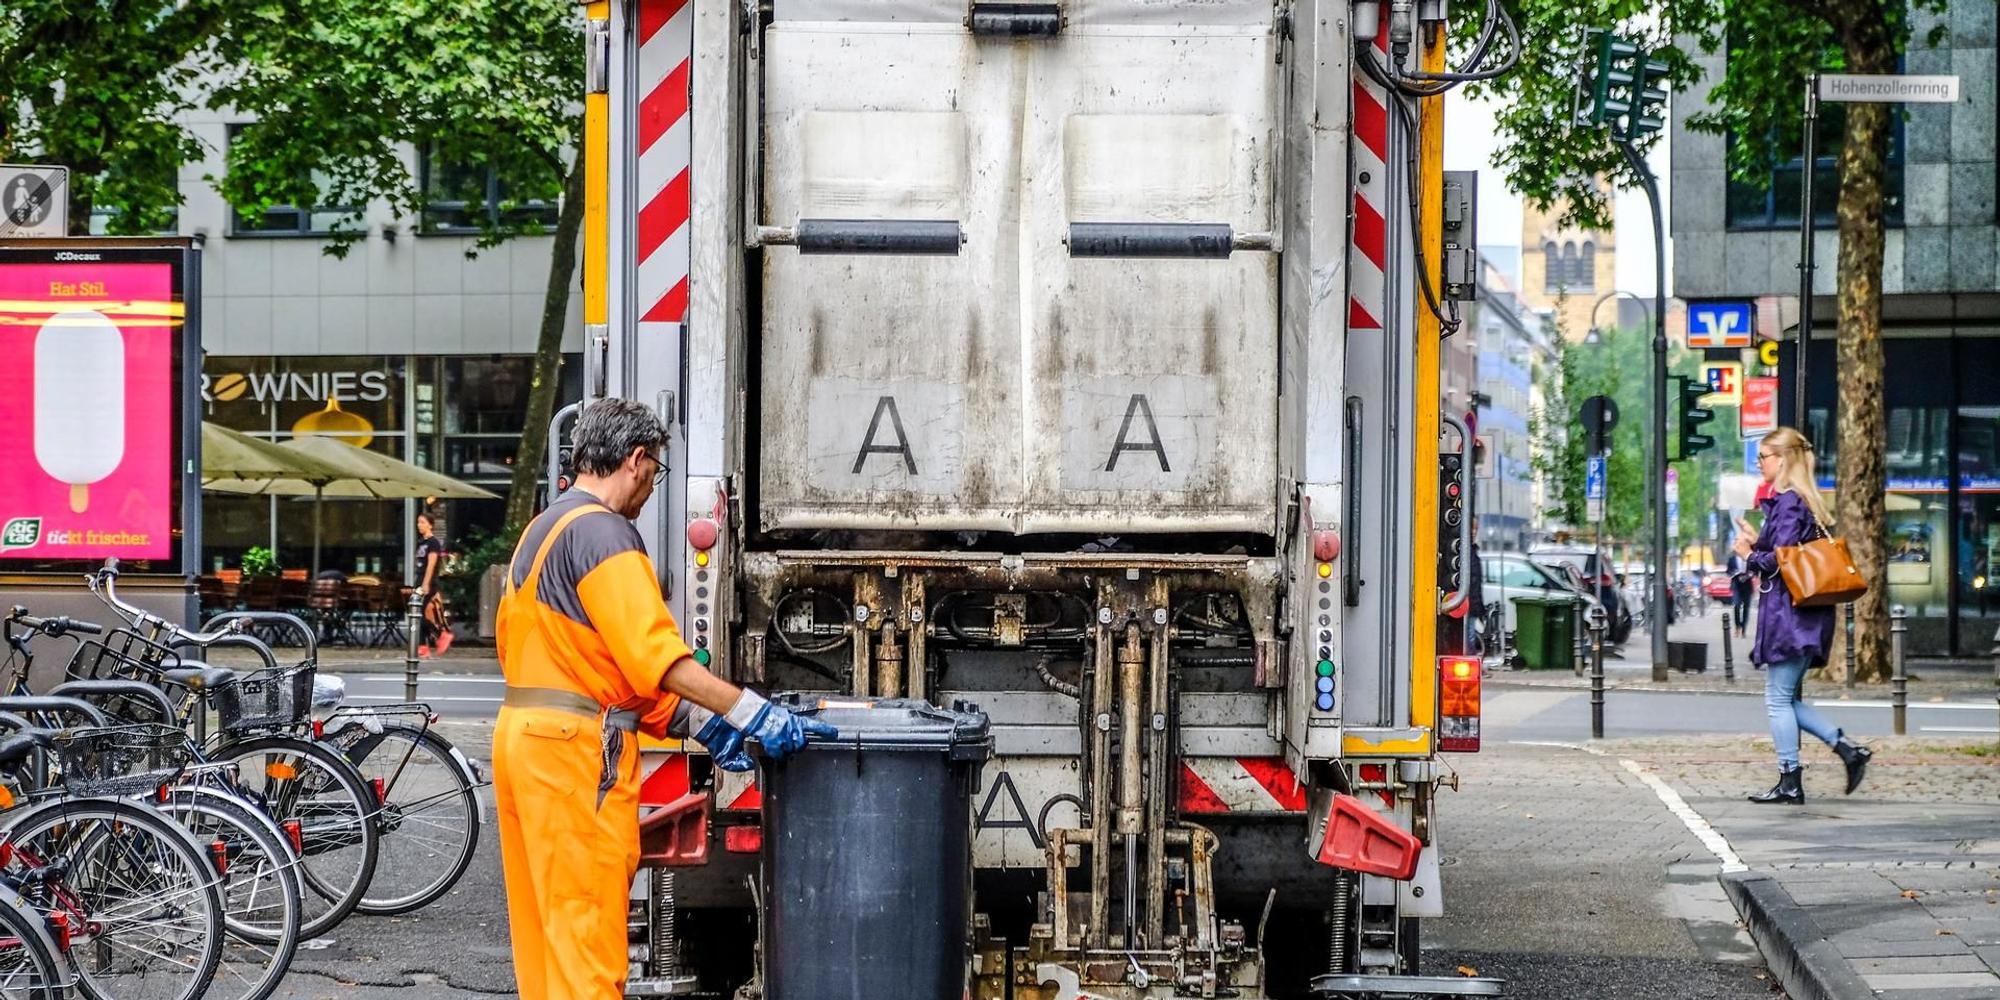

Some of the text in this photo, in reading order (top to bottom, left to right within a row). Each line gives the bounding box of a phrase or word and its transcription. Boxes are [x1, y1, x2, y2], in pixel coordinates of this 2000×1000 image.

[1831, 79, 1949, 98] Hohenzollernring
[54, 251, 101, 261] JCDecaux
[50, 281, 109, 297] Hat Stil.
[851, 396, 918, 476] A
[1104, 393, 1171, 473] A
[15, 521, 36, 533] tic
[9, 532, 34, 543] tac
[46, 530, 151, 546] tickt frischer.
[975, 771, 1046, 849] A
